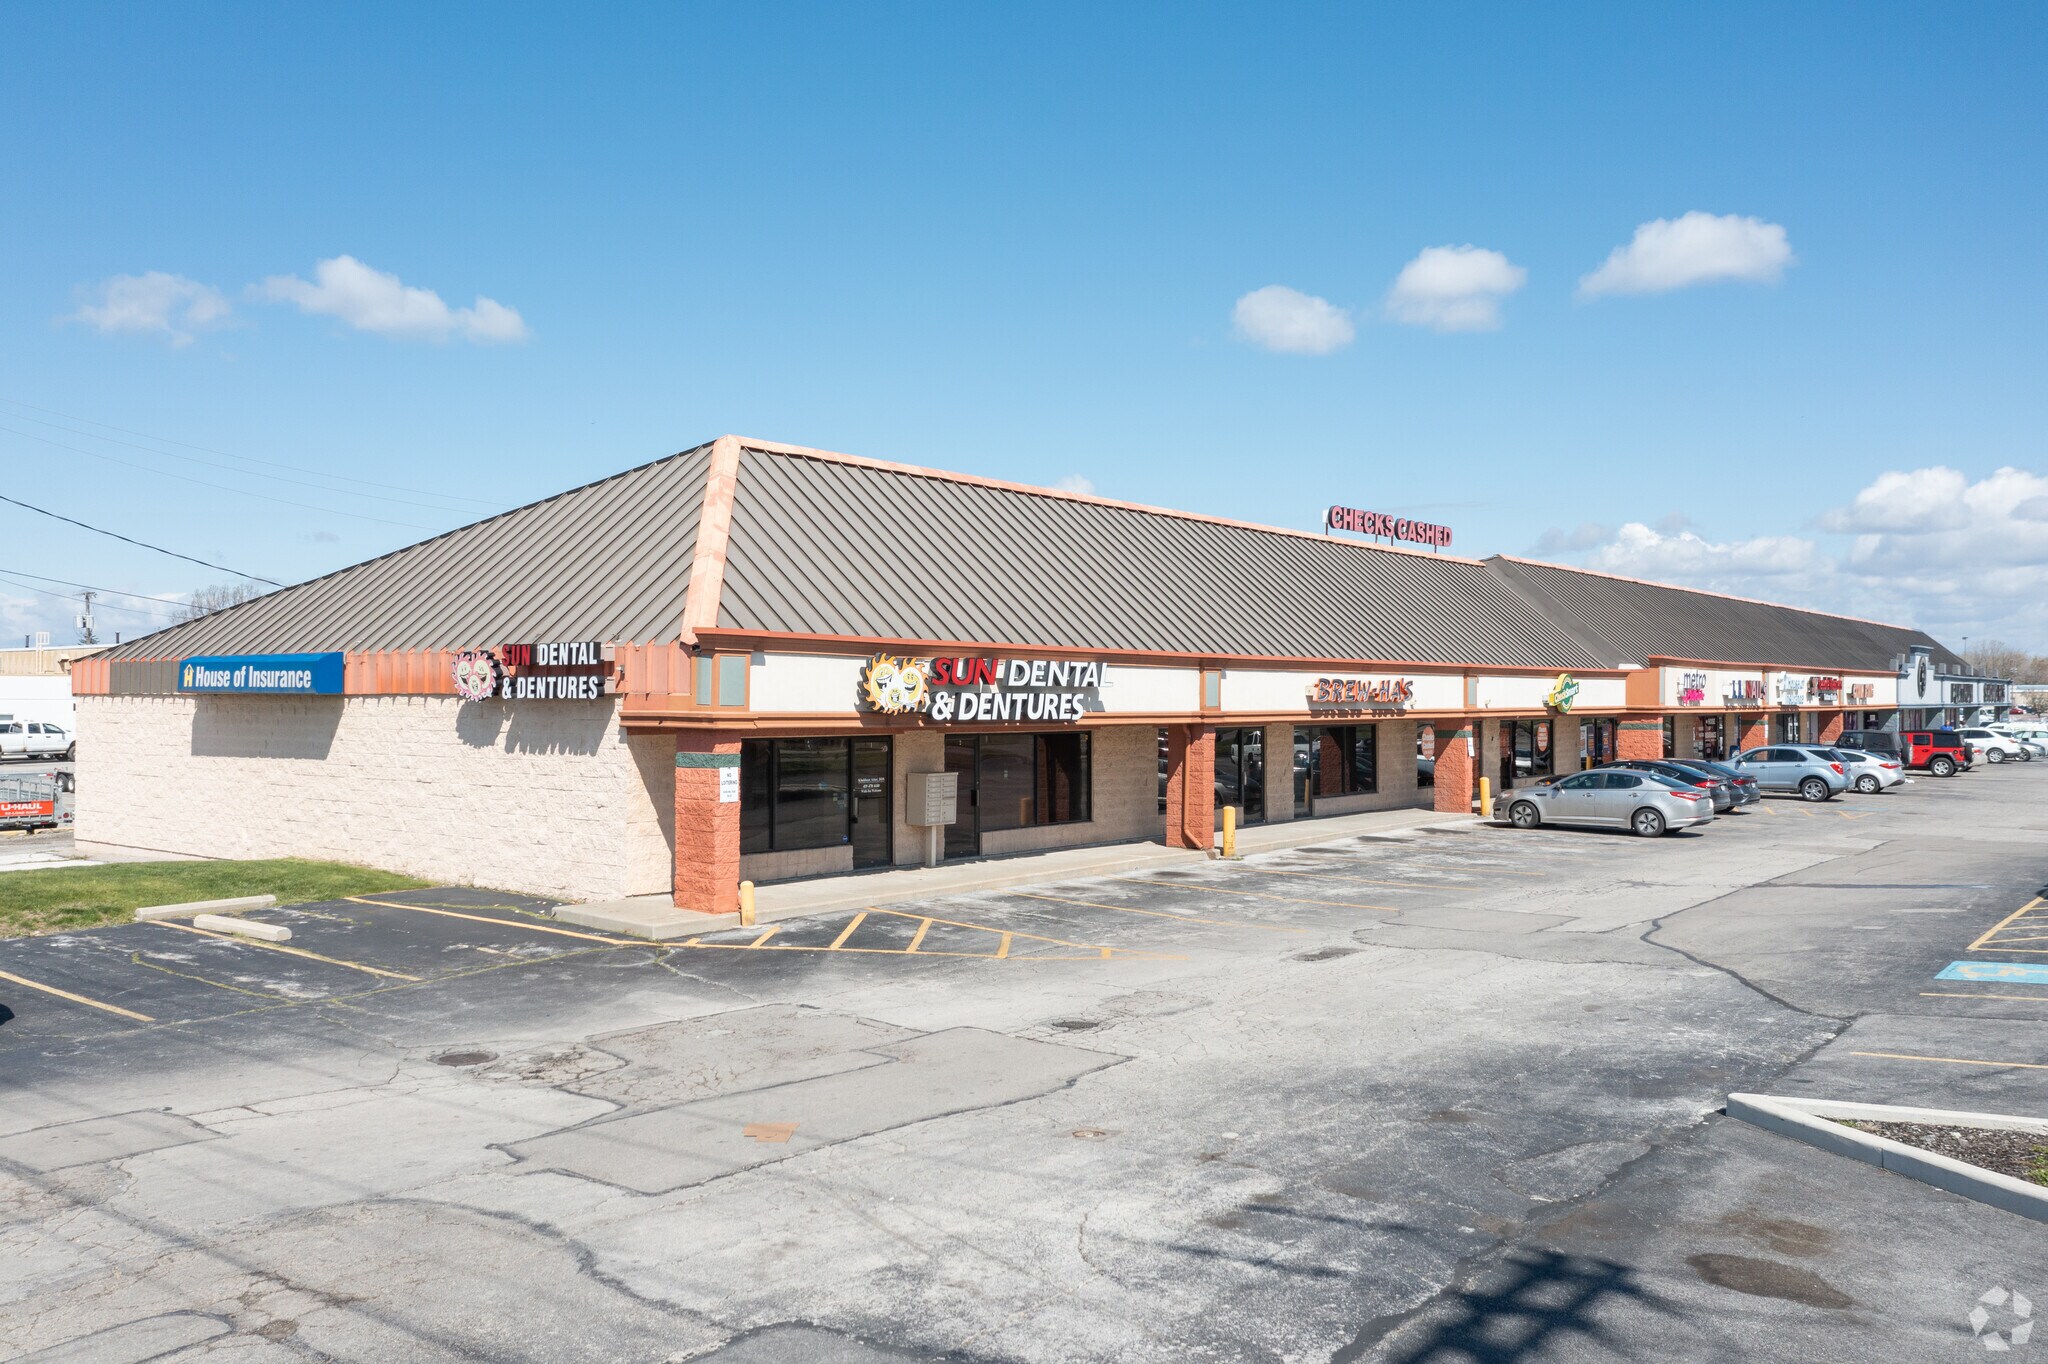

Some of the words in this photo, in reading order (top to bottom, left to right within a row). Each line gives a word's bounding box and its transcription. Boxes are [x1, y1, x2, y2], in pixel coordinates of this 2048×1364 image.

[1329, 504, 1394, 537] CHECKS
[1396, 517, 1453, 547] CASHED
[502, 643, 531, 666] SUN
[538, 641, 597, 666] DENTAL
[195, 666, 231, 688] House
[233, 665, 247, 688] of
[249, 665, 312, 689] Insurance
[931, 656, 998, 686] SUN
[1007, 660, 1114, 687] DENTAL
[1683, 670, 1707, 689] metro
[502, 676, 514, 700] &
[517, 675, 598, 700] DENTURES
[932, 691, 952, 720] &
[958, 692, 1084, 721] DENTURES
[1, 803, 43, 811] U-HAUL
